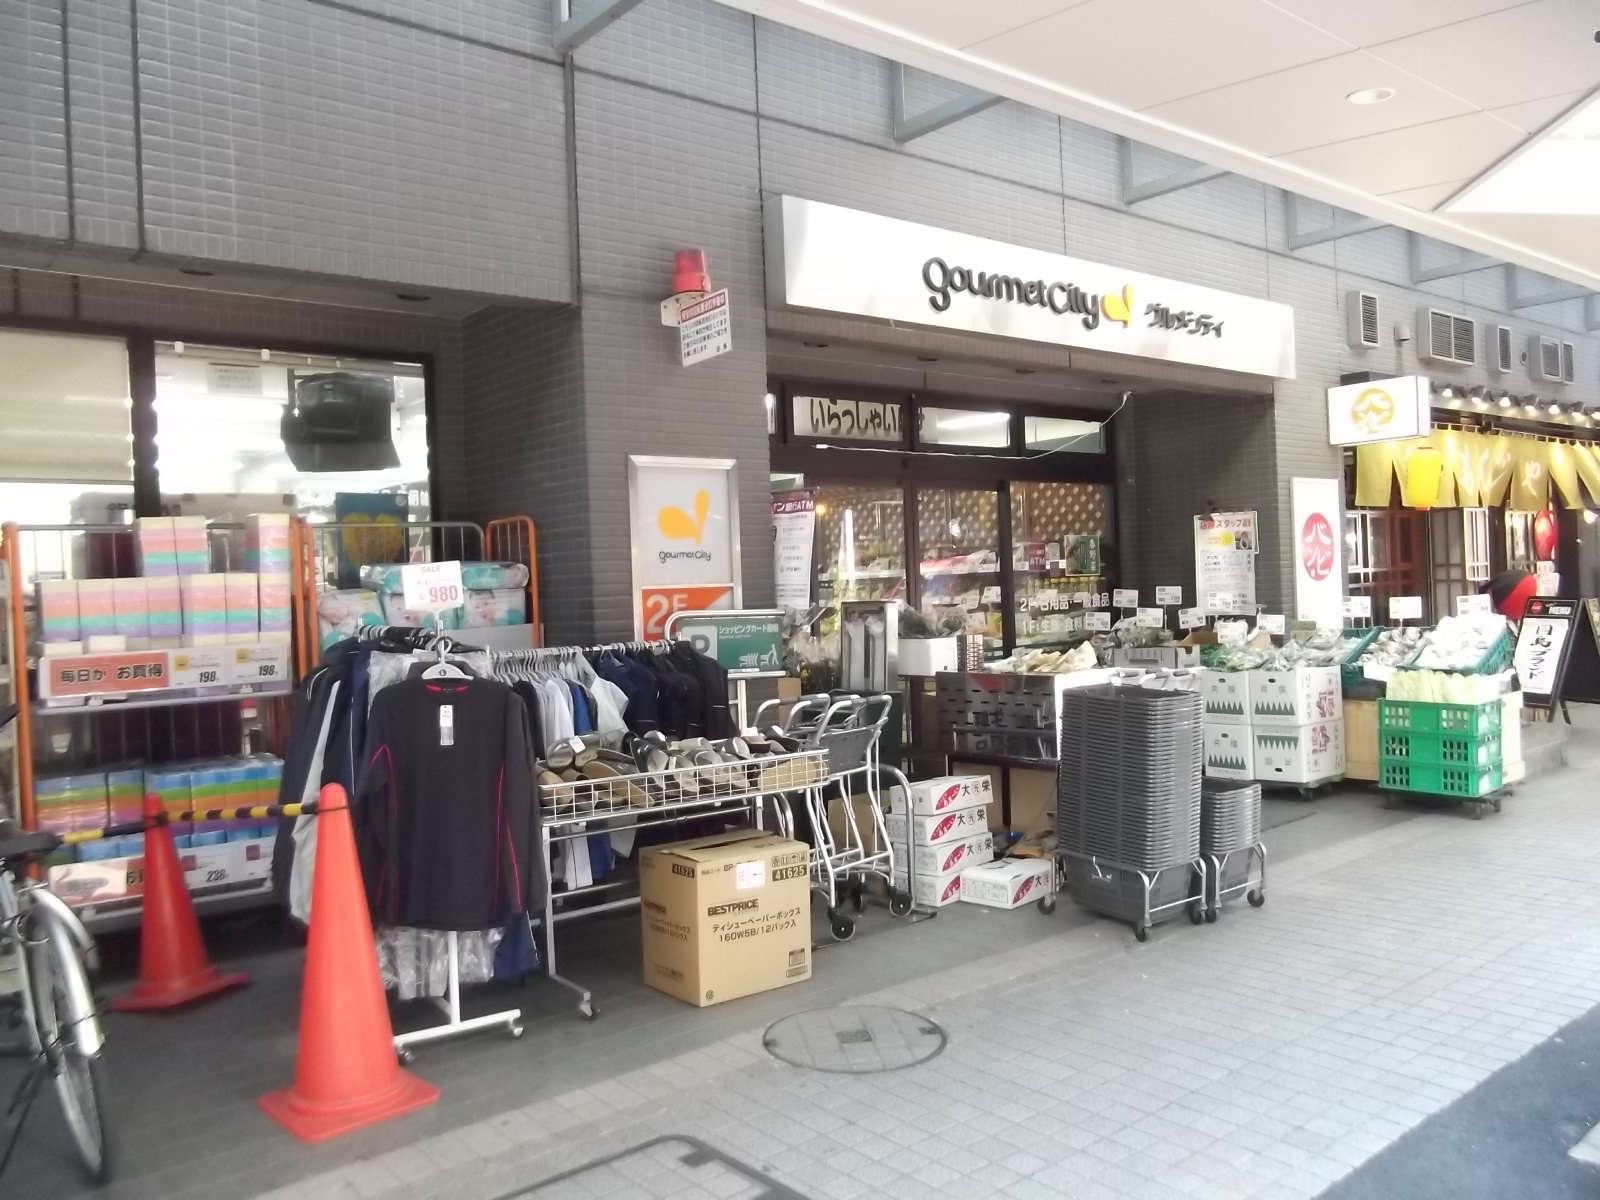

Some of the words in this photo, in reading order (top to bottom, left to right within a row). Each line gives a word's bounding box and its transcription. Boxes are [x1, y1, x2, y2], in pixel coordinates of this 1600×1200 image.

[1144, 302, 1224, 338] グルメシティ
[810, 397, 925, 437] いらっしゃい
[421, 565, 440, 573] SALE
[429, 585, 458, 602] 980
[690, 634, 711, 654] P
[60, 668, 106, 683] 毎日が
[116, 663, 163, 680] お買得
[199, 671, 216, 683] 198
[258, 665, 275, 676] 198
[774, 865, 806, 881] 41625
[708, 898, 759, 917] BESTPRICE
[712, 907, 802, 933] ティシューペーパーボックス
